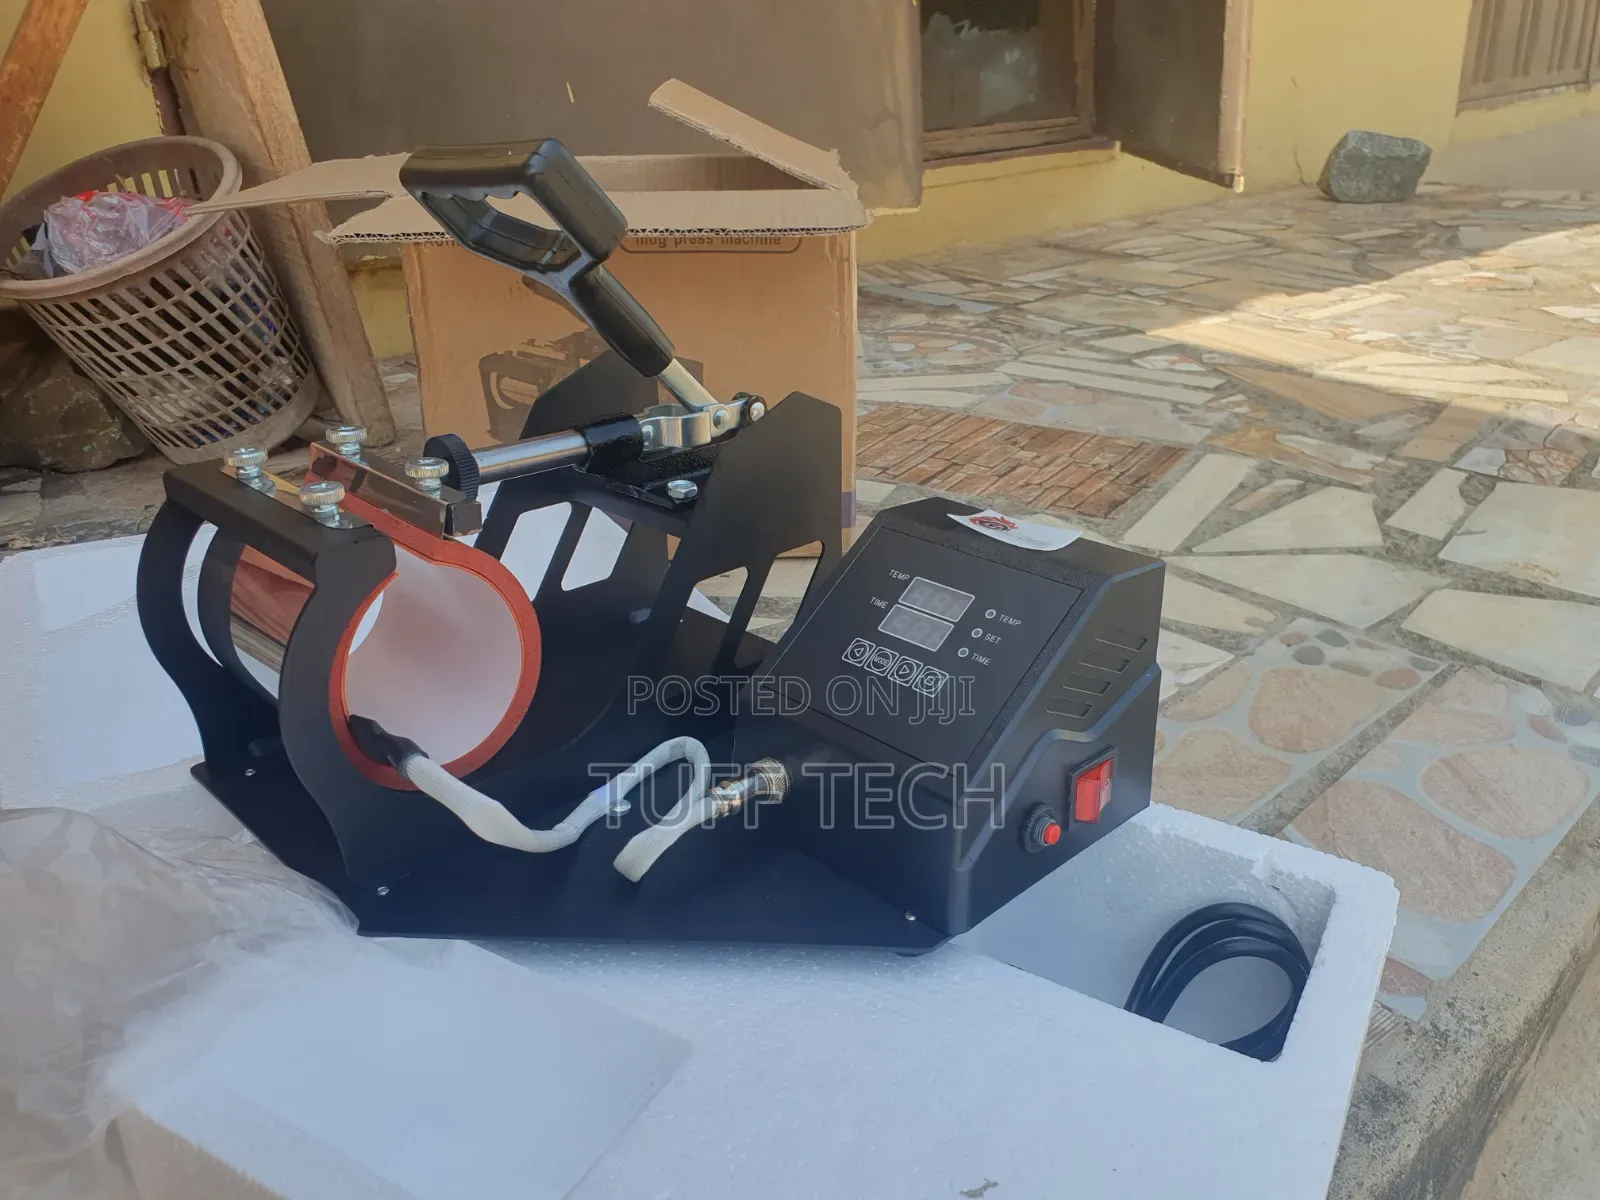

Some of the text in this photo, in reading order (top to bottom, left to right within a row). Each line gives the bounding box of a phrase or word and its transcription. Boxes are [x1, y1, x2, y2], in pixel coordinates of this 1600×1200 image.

[674, 236, 714, 248] press
[889, 569, 910, 581] TEMP
[870, 596, 889, 610] TIME
[999, 613, 1022, 626] TEMP
[984, 633, 1002, 644] SET
[873, 655, 890, 667] MODE
[971, 652, 992, 666] TIME
